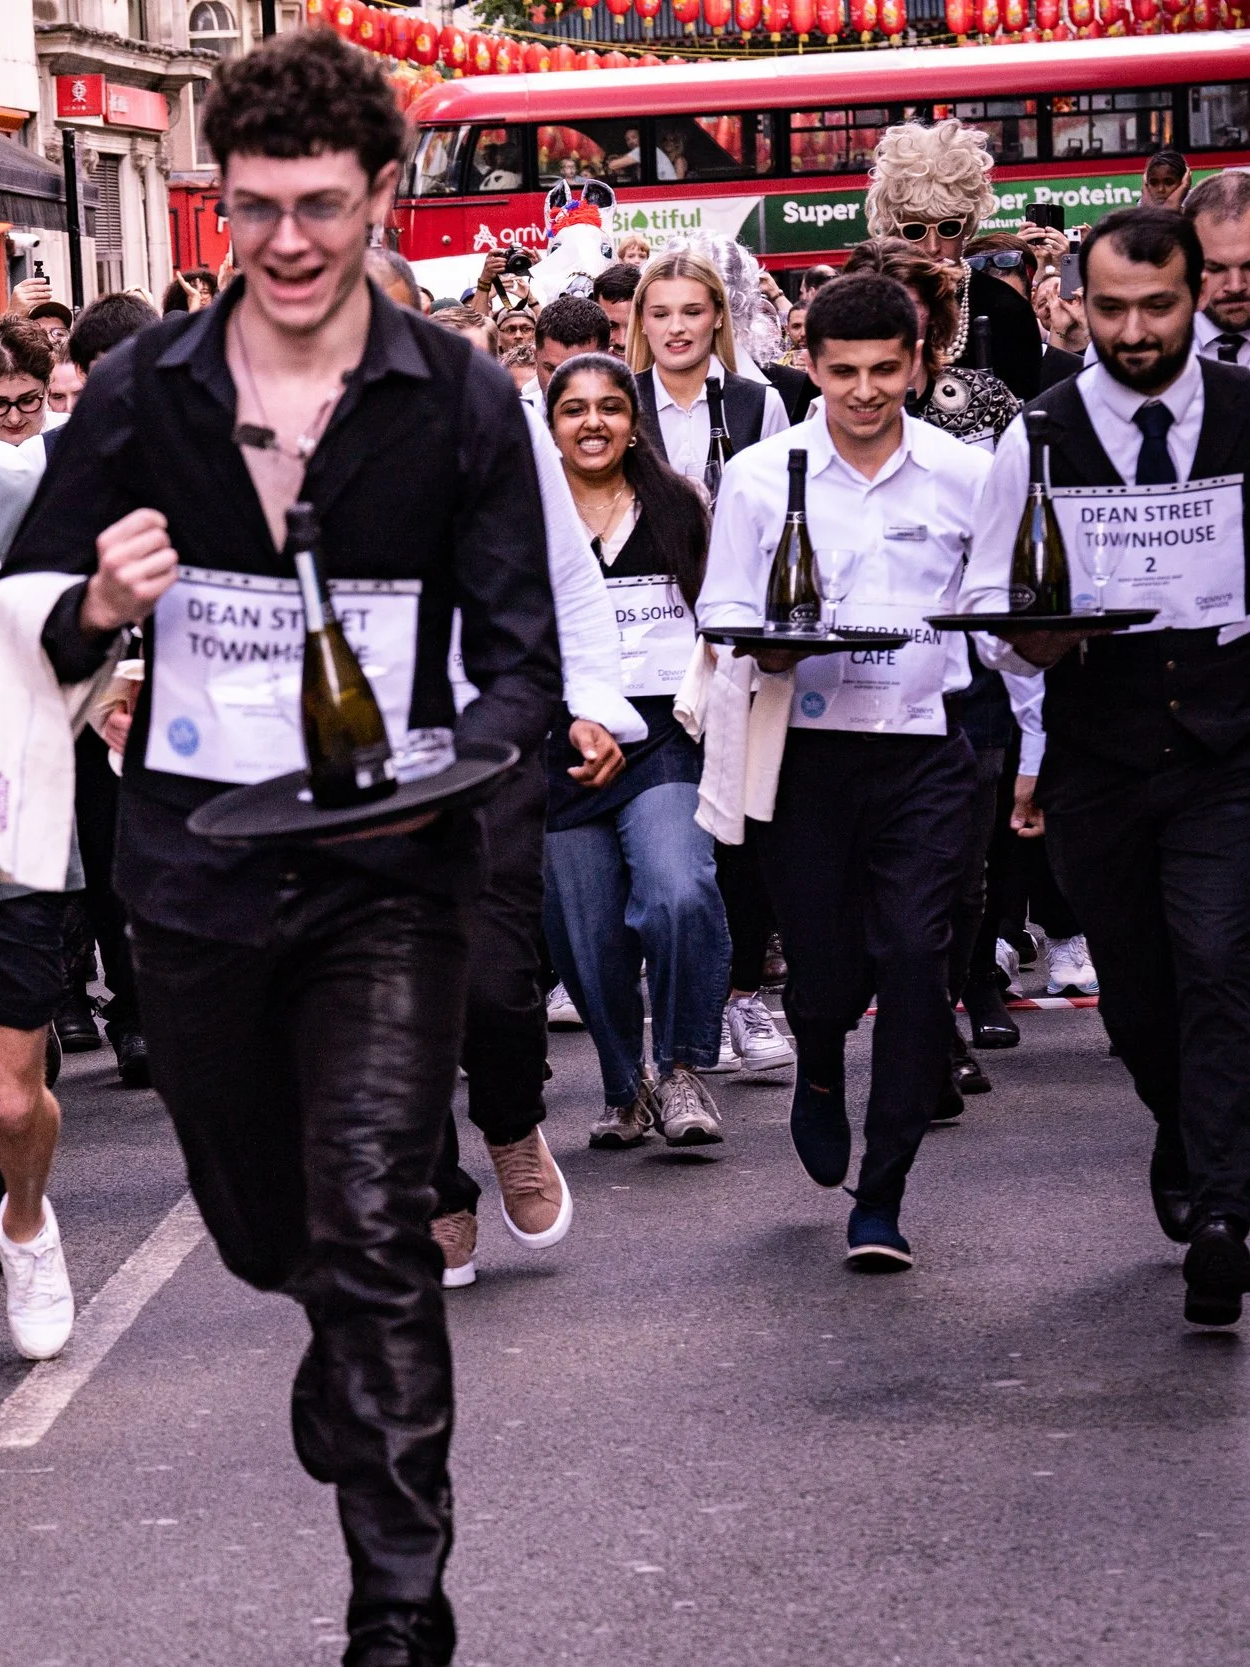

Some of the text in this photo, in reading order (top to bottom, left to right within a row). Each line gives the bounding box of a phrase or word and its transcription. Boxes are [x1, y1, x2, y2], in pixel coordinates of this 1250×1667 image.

[783, 201, 860, 226] Super
[1081, 499, 1215, 524] DEAN STREET
[1085, 524, 1216, 548] TOWNHOUSE
[1145, 557, 1157, 573] 2
[187, 598, 371, 632] DEAN STET
[641, 605, 685, 621] SOHO
[188, 632, 371, 664] TOWNHE
